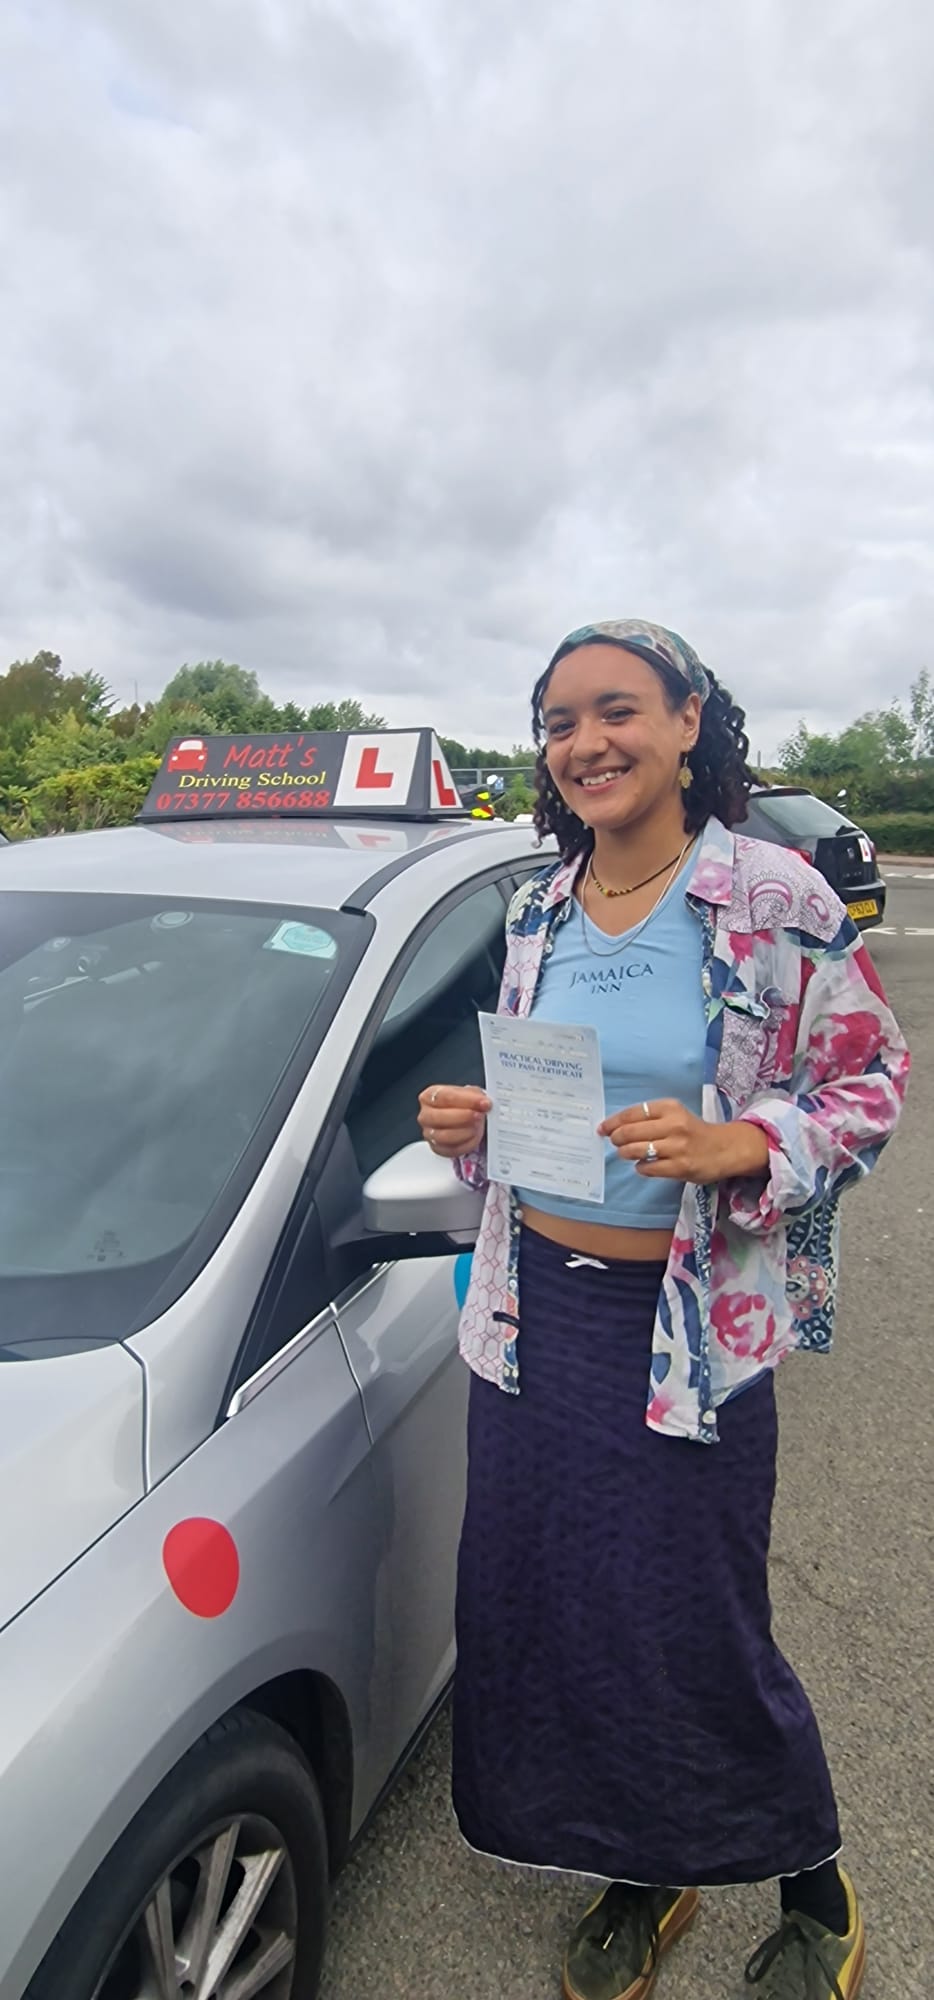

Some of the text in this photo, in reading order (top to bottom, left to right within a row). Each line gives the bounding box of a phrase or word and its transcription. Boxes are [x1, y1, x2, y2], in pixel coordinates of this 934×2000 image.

[223, 737, 317, 768] Matt's
[355, 748, 394, 789] L
[178, 771, 327, 789] Driving School
[432, 760, 457, 806] L
[156, 791, 330, 810] 07377 856688
[569, 963, 654, 989] JAMAICA
[592, 982, 622, 994] INN
[499, 1051, 583, 1071] PRACTICAL DRIVING
[501, 1060, 517, 1069] TEST
[537, 1063, 583, 1079] CERTIFICATE
